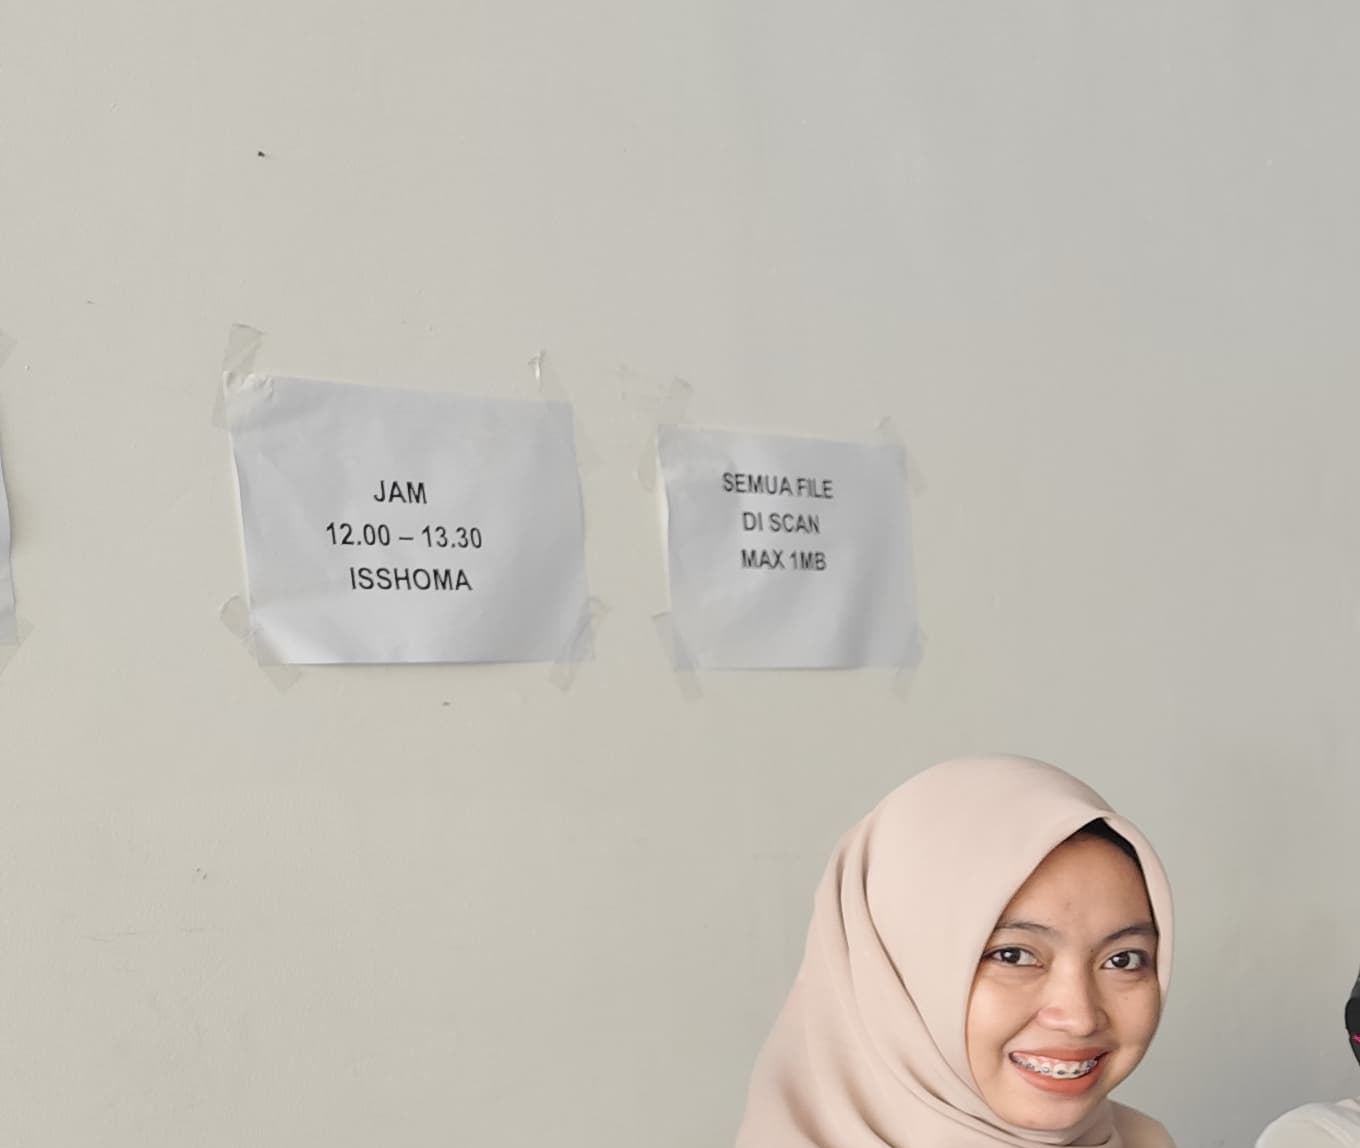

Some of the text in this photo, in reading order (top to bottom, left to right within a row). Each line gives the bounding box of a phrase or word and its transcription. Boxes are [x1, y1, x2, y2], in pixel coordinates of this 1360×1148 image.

[373, 480, 428, 504] JAM
[722, 472, 834, 499] SEMUA FILE
[743, 511, 821, 534] DI SCAN
[326, 522, 390, 546] 12.00
[422, 525, 482, 549] 13.30
[741, 549, 827, 571] MAX 1MB
[350, 567, 473, 590] ISSHOMA
